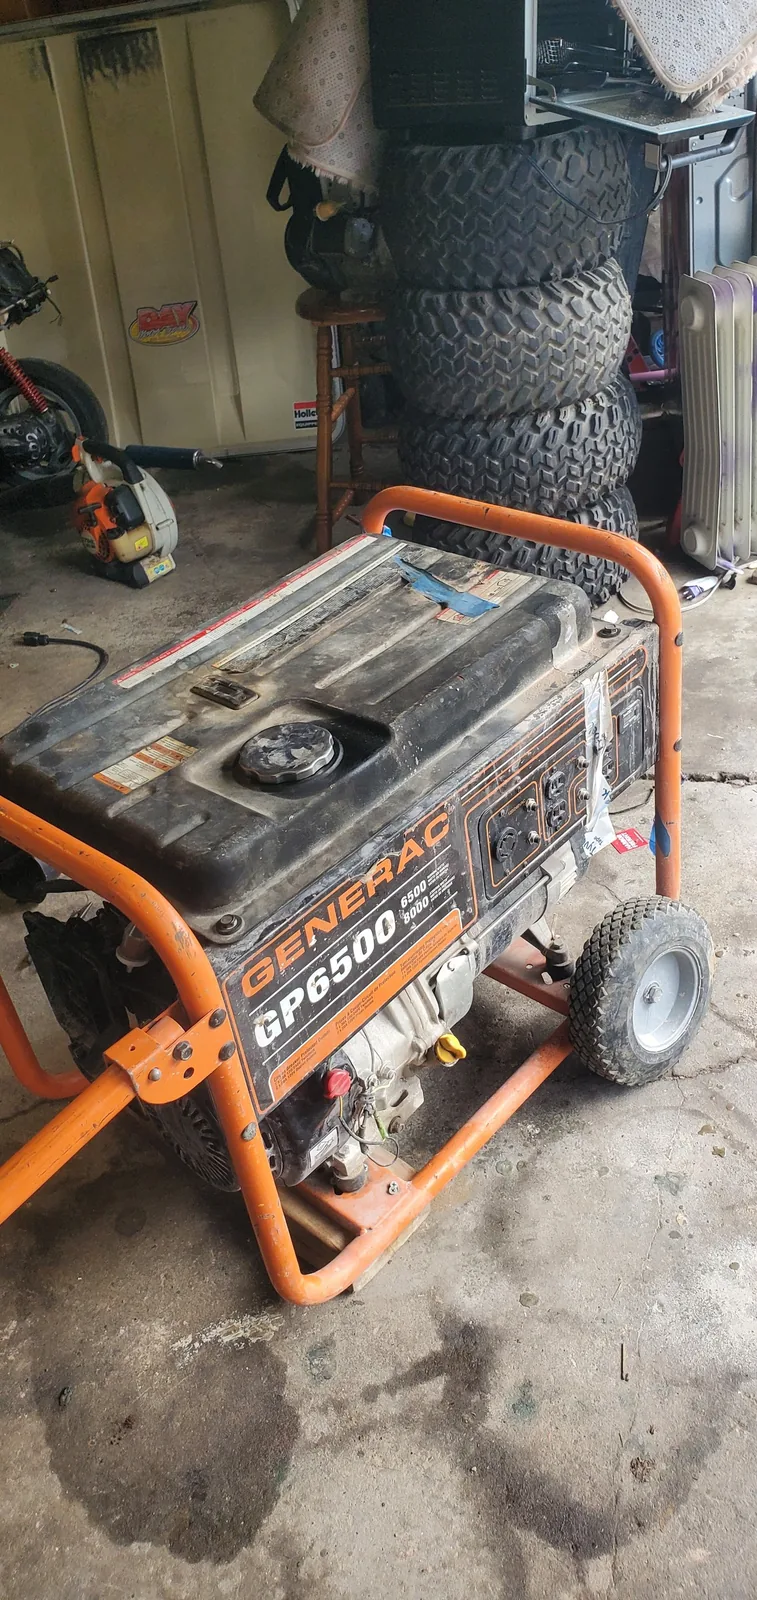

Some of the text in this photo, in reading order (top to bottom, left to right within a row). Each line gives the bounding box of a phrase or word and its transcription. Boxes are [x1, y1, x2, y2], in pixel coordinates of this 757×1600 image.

[241, 812, 449, 997] GENERAC
[401, 880, 426, 908] 6500
[404, 896, 429, 924] 8000
[254, 910, 396, 1048] GP6500
